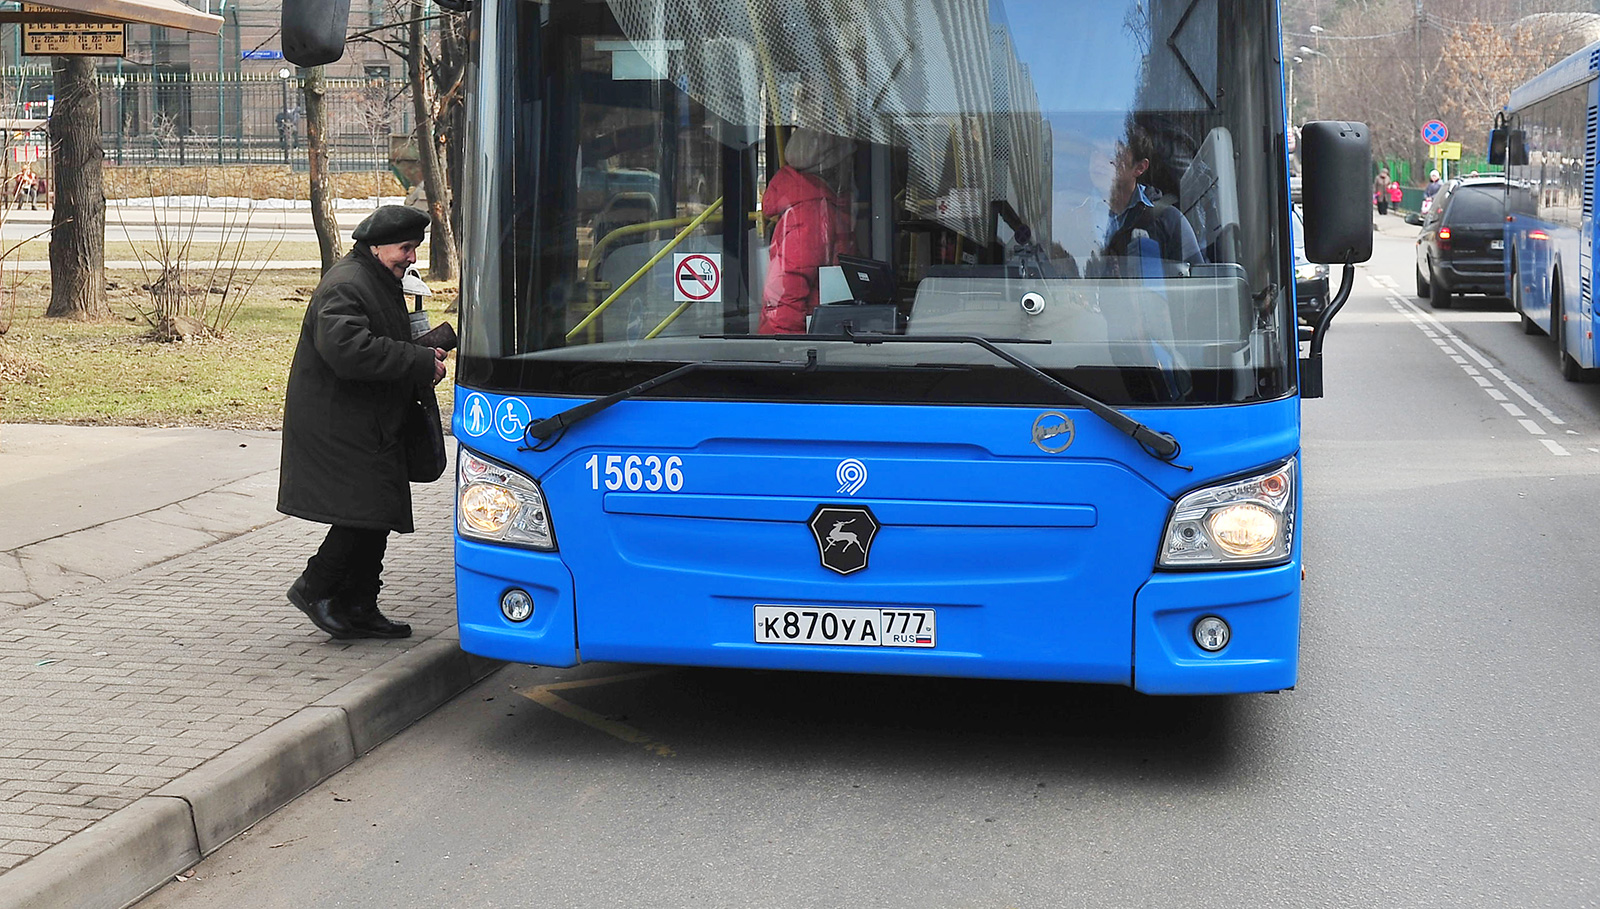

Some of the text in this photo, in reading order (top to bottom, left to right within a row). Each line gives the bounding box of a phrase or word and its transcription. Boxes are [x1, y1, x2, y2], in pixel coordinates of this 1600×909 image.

[585, 454, 684, 492] 15636
[764, 611, 926, 642] К870УА 777
[893, 634, 915, 643] RUS
